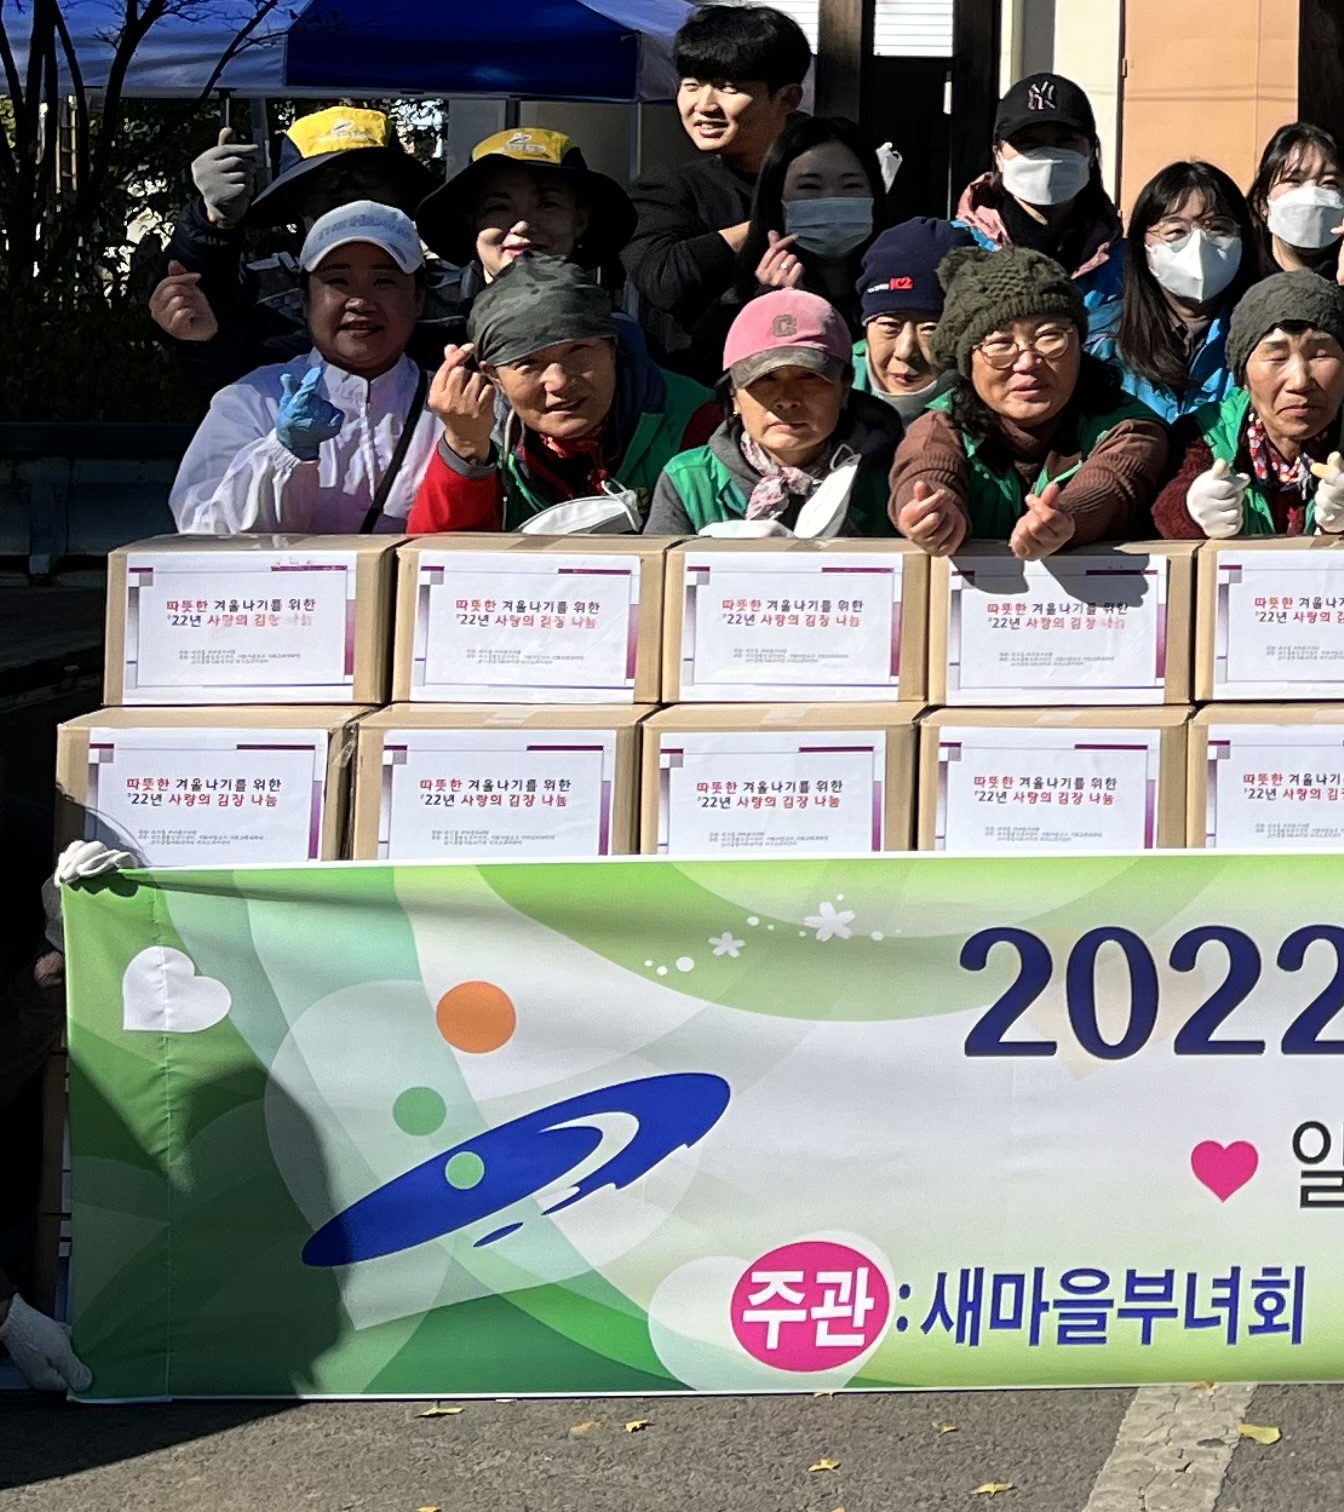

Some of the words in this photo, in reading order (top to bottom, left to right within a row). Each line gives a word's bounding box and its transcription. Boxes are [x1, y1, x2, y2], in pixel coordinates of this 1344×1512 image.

[127, 778, 169, 791] 따뜻한
[176, 778, 246, 792] 겨울나기를
[253, 779, 281, 792] 위한
[420, 779, 462, 792] 따뜻한
[469, 779, 537, 792] 겨울나기를
[544, 779, 571, 792] 위한
[974, 776, 1013, 790] 따뜻한
[1020, 777, 1085, 790] 겨울나기를
[1092, 778, 1117, 790] 위한
[1243, 773, 1283, 786] 따뜻한
[697, 782, 737, 794] 따뜻한
[743, 781, 810, 794] 겨울나기를
[816, 780, 843, 793] 위한
[168, 794, 210, 807] 사랑의
[218, 794, 244, 807] 김장
[252, 794, 277, 807] 나눔
[461, 795, 501, 807] 사랑의
[510, 795, 535, 807] 김장
[542, 795, 566, 806] 나눔
[1013, 792, 1051, 804] 사랑의
[1059, 792, 1083, 806] 김장
[1089, 793, 1114, 805] 나눔
[1283, 788, 1321, 801] 사랑의
[737, 796, 776, 809] 사랑의
[784, 796, 808, 808] 김장
[815, 796, 839, 807] 나눔
[741, 1266, 876, 1349] 주관
